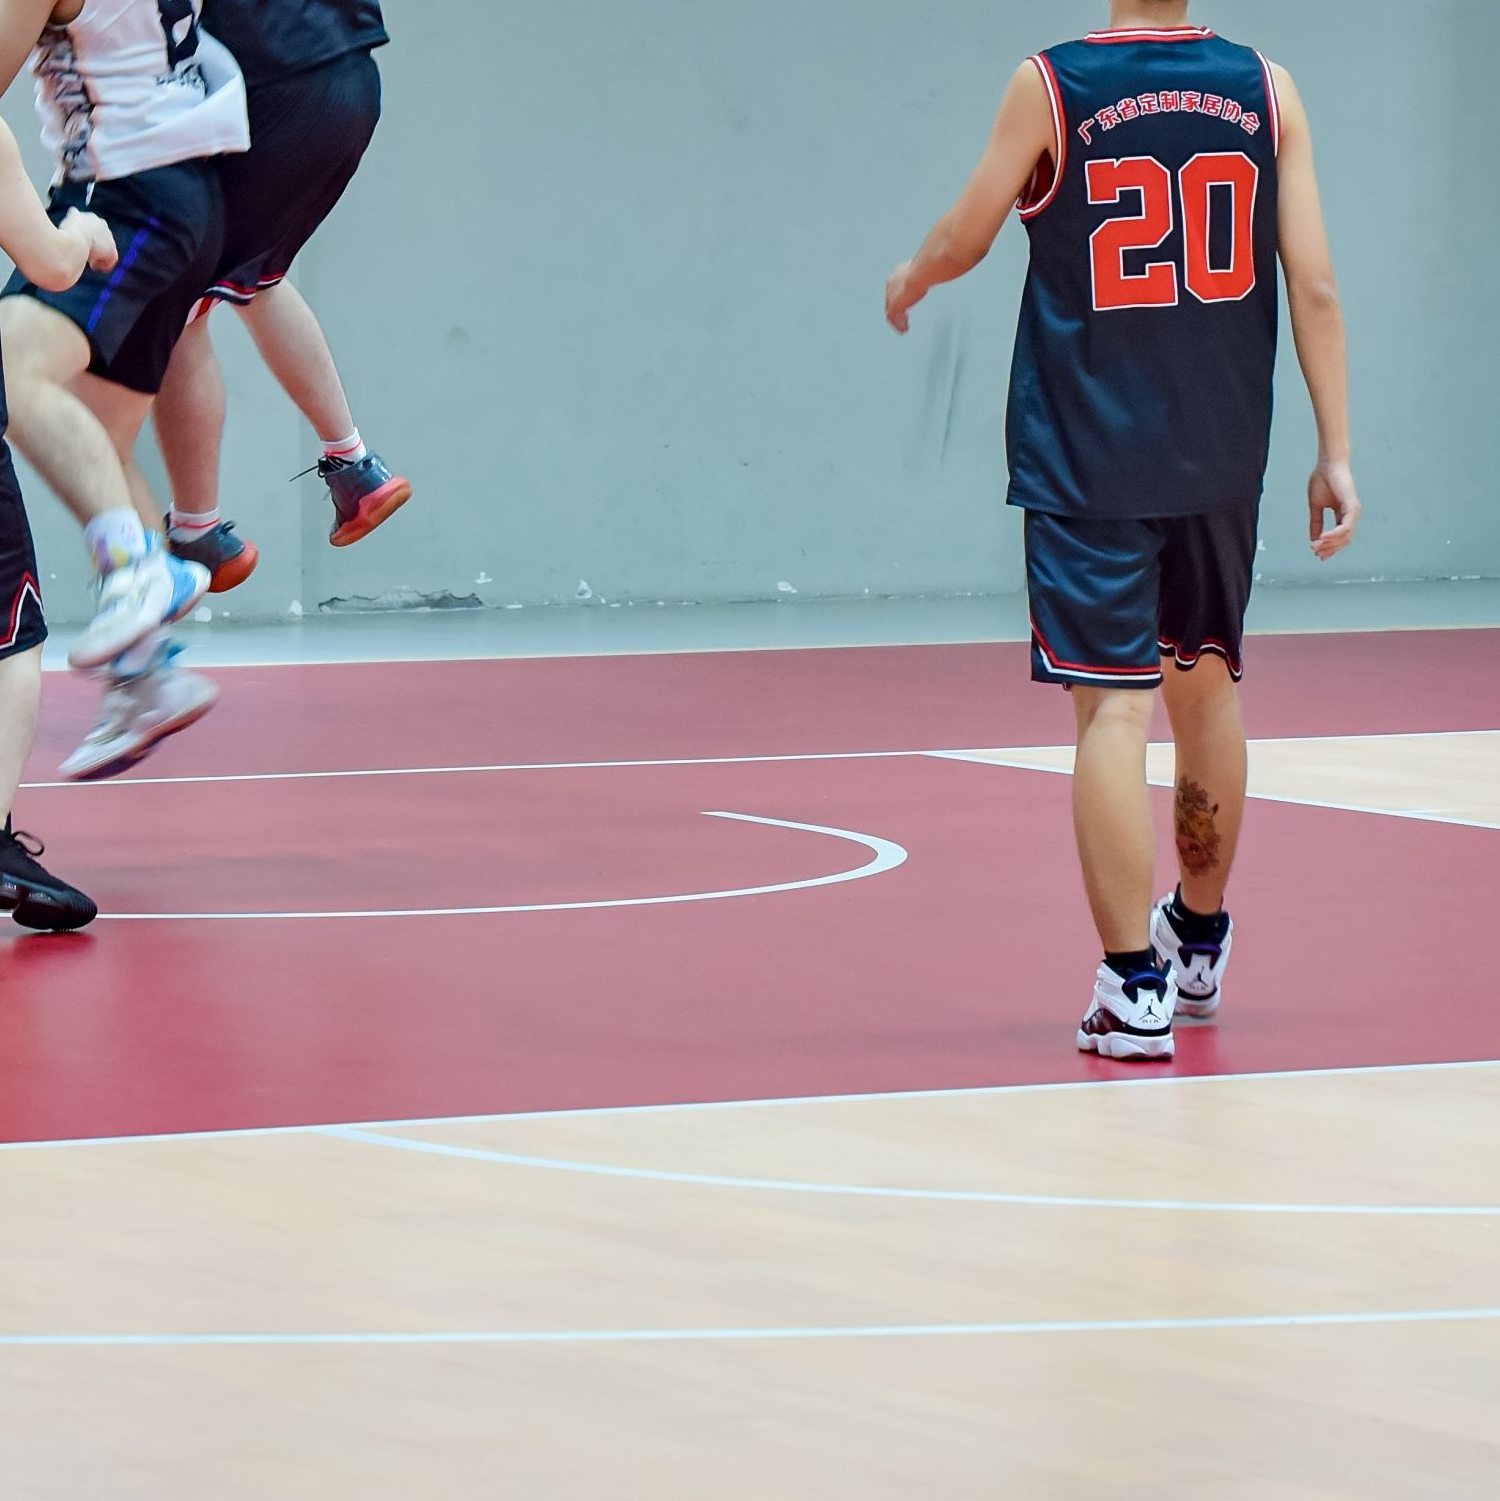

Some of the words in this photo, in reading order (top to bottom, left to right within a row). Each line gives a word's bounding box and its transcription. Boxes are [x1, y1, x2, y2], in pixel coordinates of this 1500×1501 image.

[1078, 90, 1261, 146] 广东省定制家居协会
[1085, 151, 1259, 312] 20
